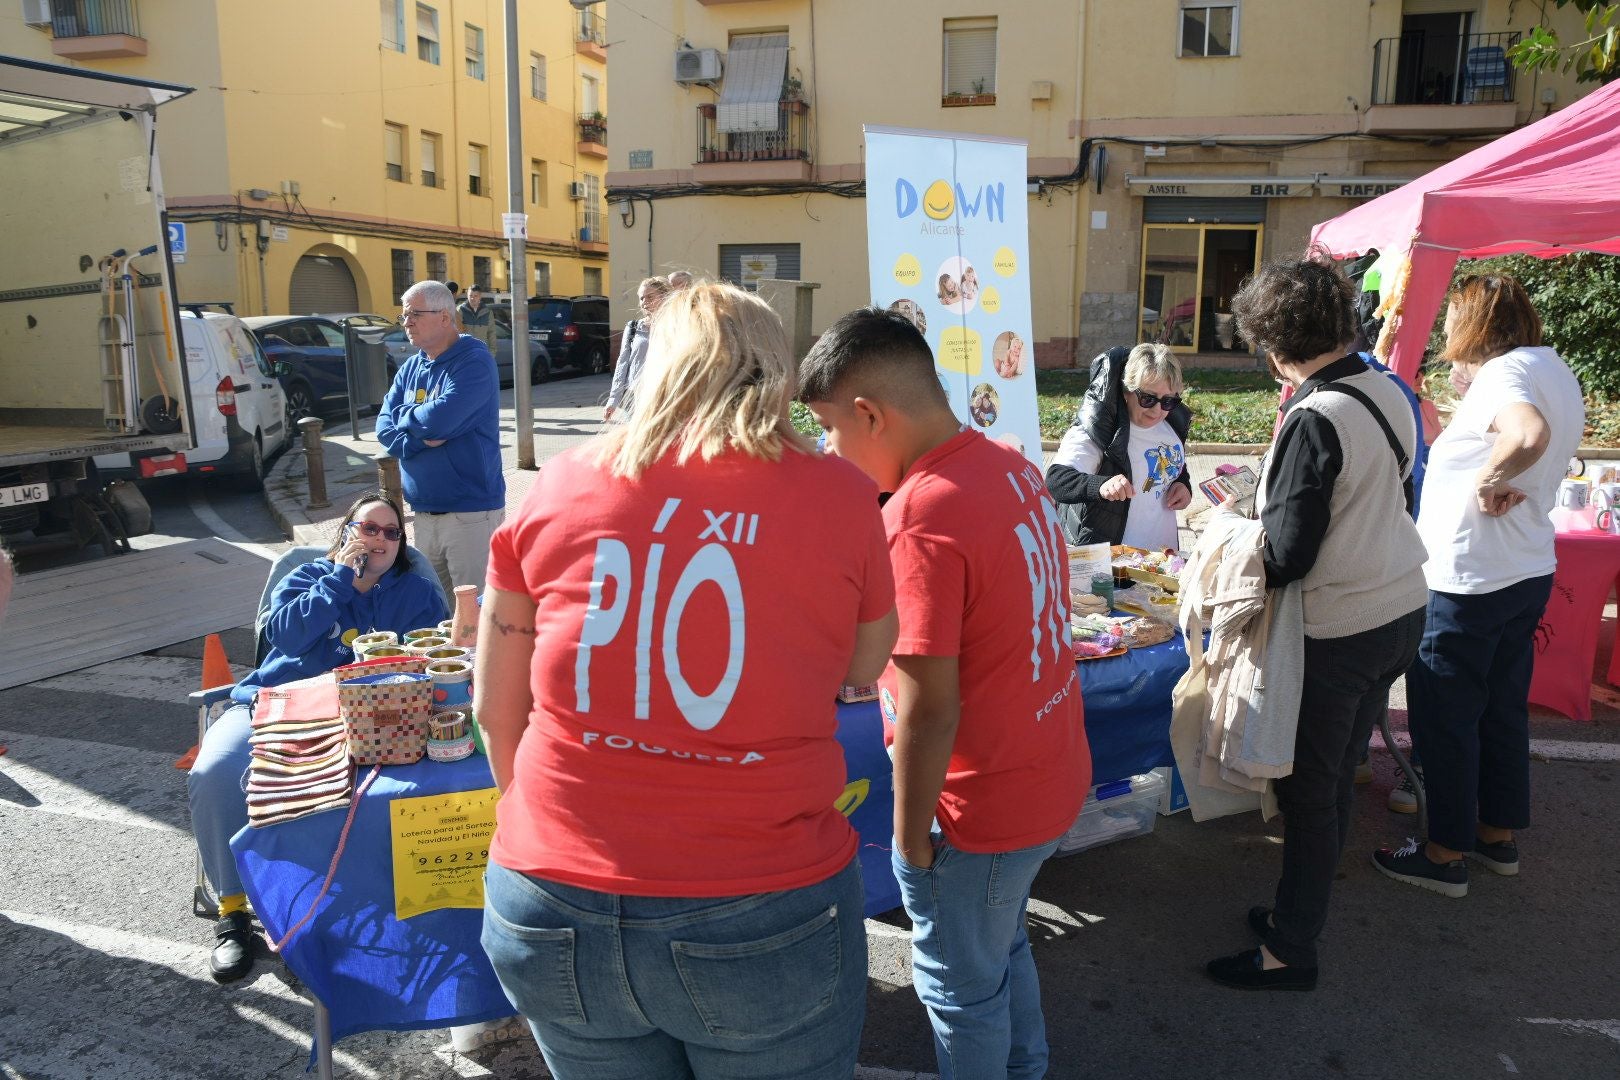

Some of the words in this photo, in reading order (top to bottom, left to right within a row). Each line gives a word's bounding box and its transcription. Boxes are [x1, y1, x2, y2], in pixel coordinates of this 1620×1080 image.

[1148, 184, 1188, 194] AMSTEL
[1250, 184, 1289, 195] BAR
[1341, 184, 1401, 195] RAFAE
[895, 178, 1004, 223] DOWN
[920, 221, 965, 236] Alicante
[12, 486, 42, 503] LMG
[697, 509, 759, 545] XII
[433, 826, 454, 835] para
[465, 821, 494, 830] Sorteo
[417, 835, 453, 845] Navidad
[471, 831, 490, 839] Niño
[419, 849, 489, 865] 96229
